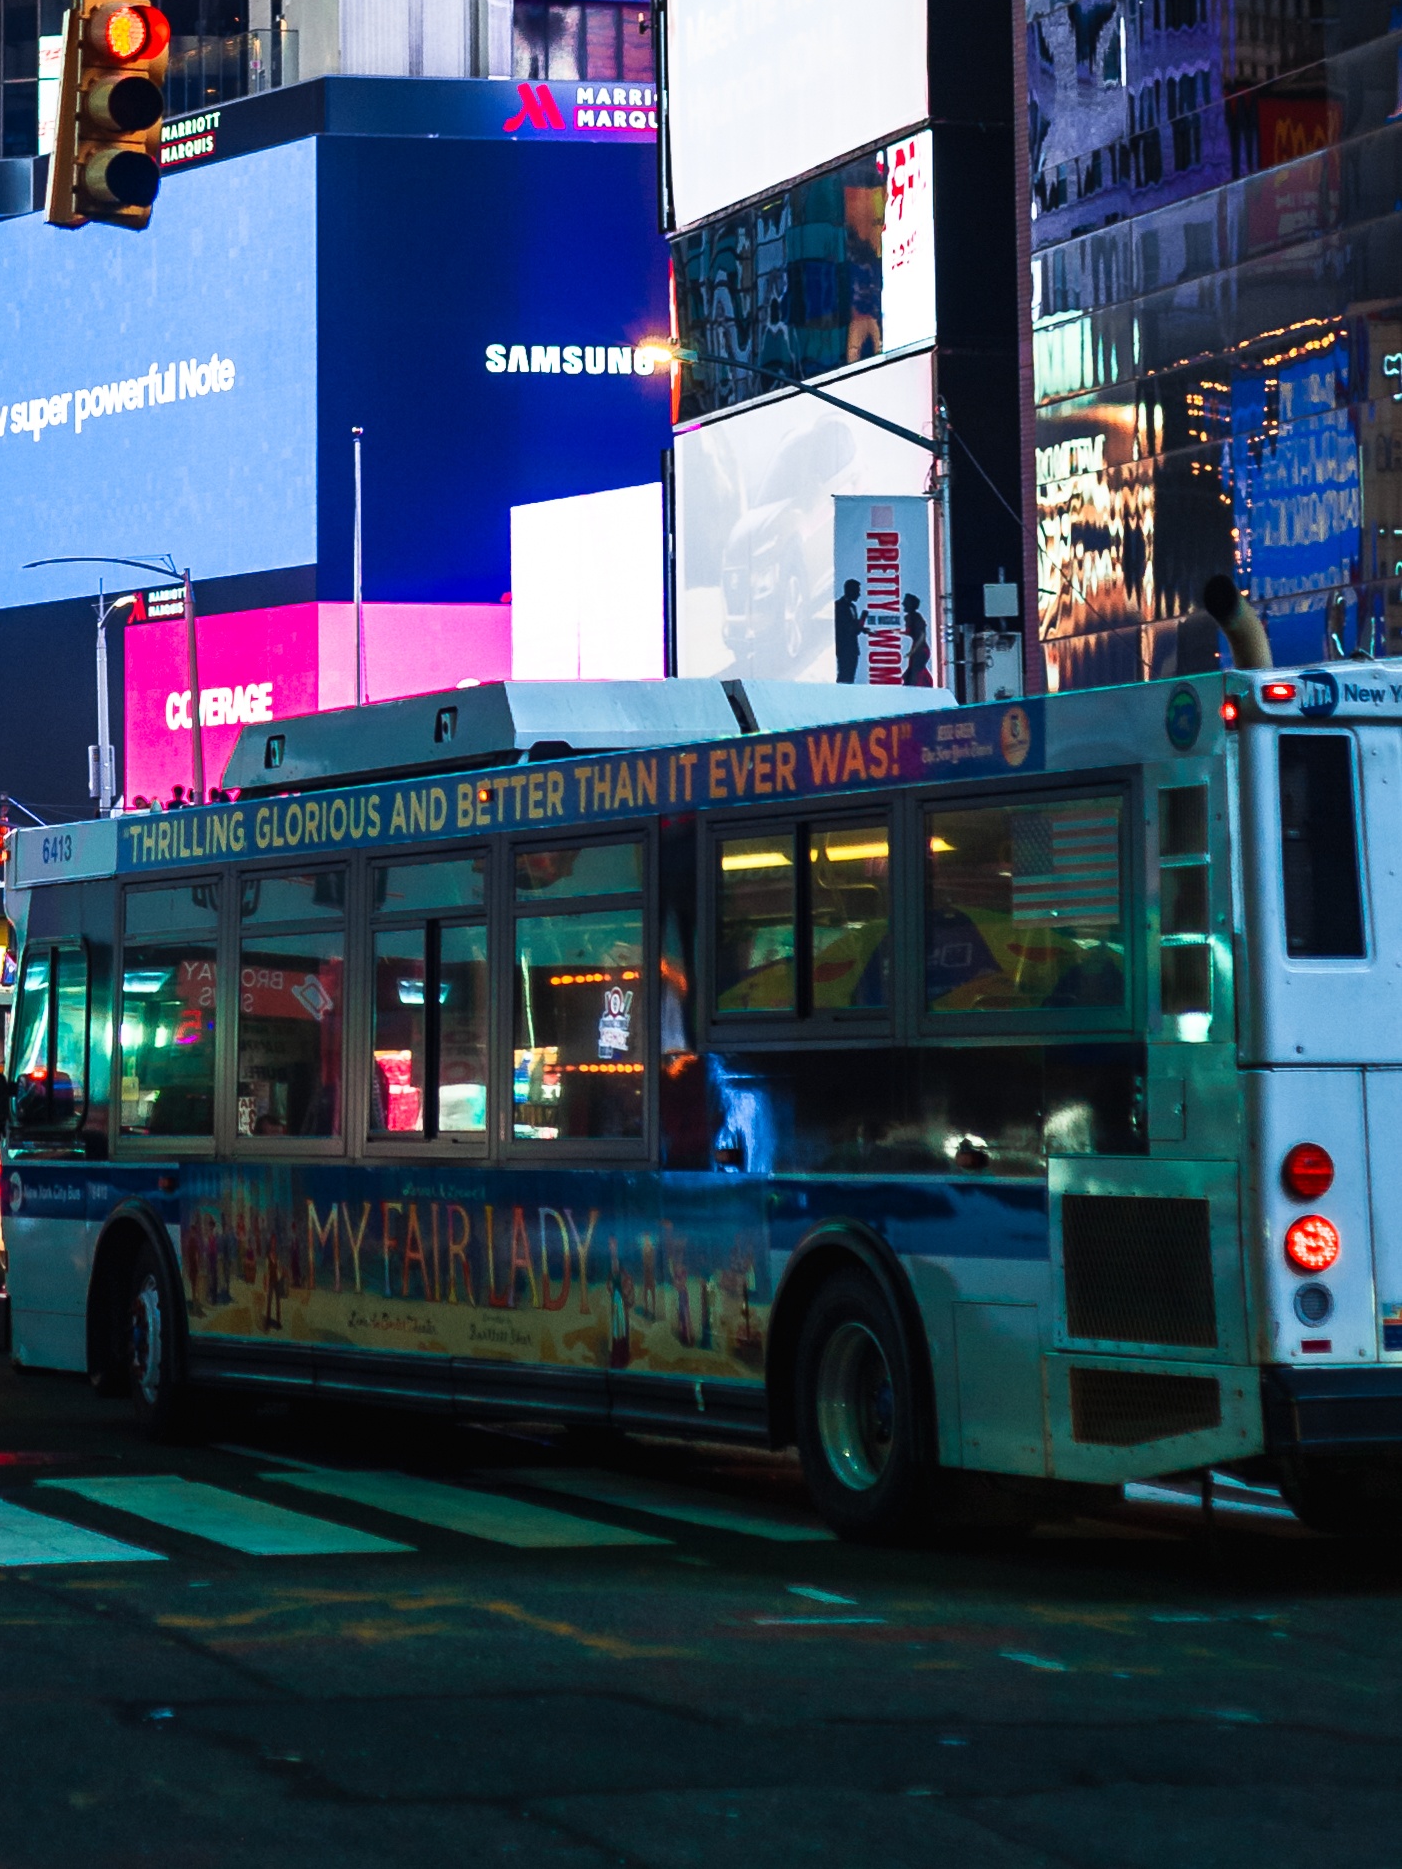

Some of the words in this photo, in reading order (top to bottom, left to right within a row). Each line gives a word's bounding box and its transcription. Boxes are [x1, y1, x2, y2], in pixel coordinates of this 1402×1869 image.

[576, 86, 658, 107] MARRI
[160, 111, 221, 143] MARRIOTT
[160, 135, 214, 164] MARQUIS
[10, 392, 72, 443] super
[75, 362, 177, 435] powerful
[179, 353, 235, 399] Note
[866, 531, 901, 613] PRETTY
[165, 682, 274, 731] COVERAGE
[1344, 683, 1386, 703] New
[255, 795, 382, 849] GLORIOUS
[389, 788, 447, 836] AND
[457, 767, 565, 829] BETTER
[574, 757, 658, 813] THAN
[668, 752, 699, 803] IT
[708, 740, 797, 799] EVER
[42, 835, 73, 864] 6413
[306, 1198, 372, 1294] MY
[380, 1199, 477, 1309] FAIR
[484, 1203, 600, 1315] LADY
